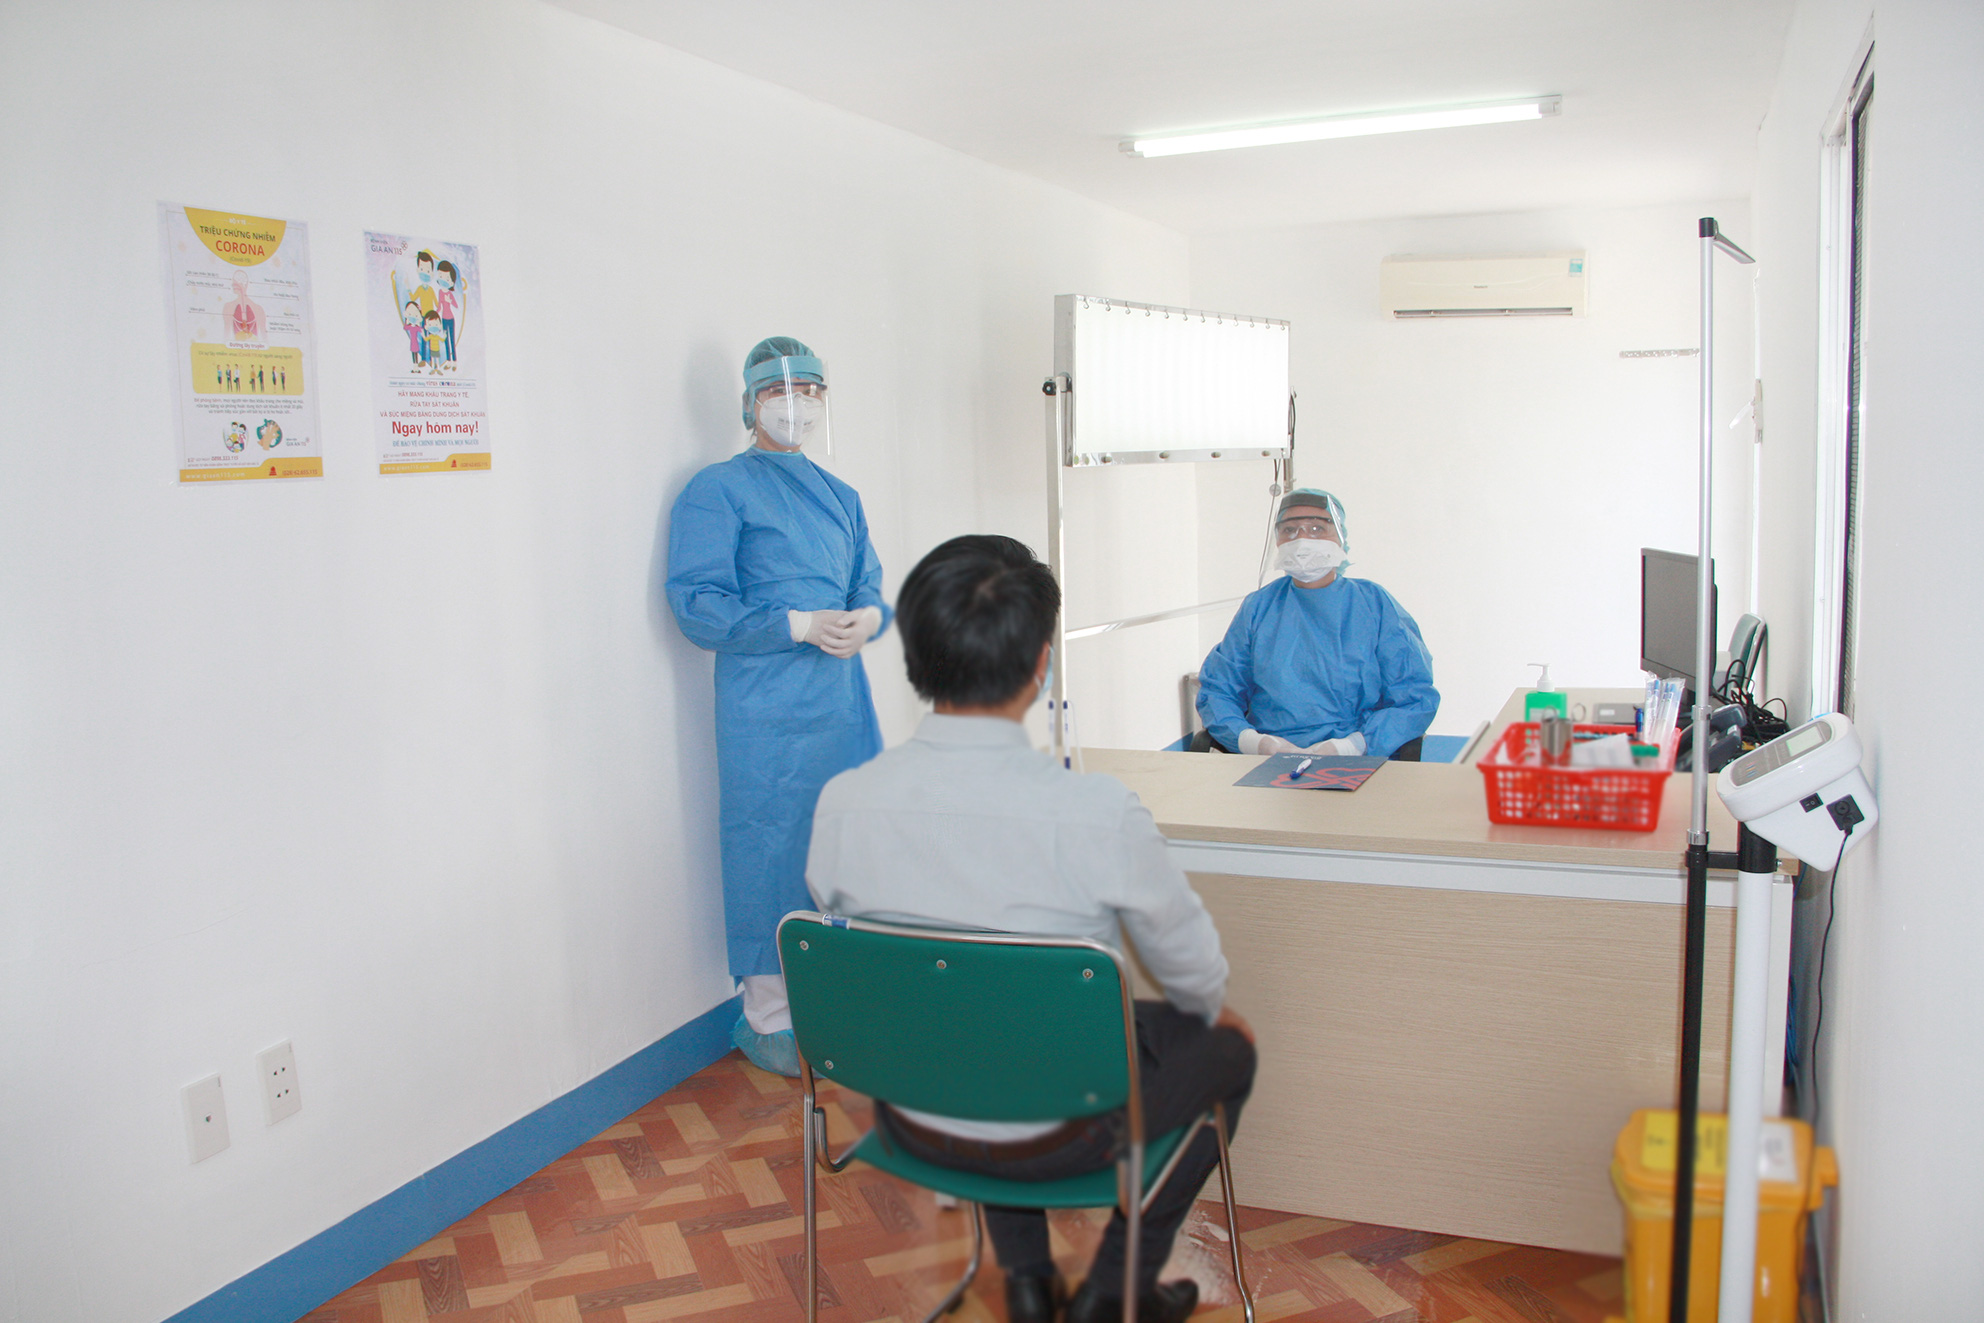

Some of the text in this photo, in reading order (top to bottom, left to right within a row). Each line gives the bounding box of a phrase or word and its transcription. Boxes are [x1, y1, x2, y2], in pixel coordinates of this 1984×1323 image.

[200, 225, 221, 236] TRIỆU
[223, 228, 251, 239] CHỨNG
[216, 240, 265, 256] CORONA
[392, 421, 478, 437] Ngay hôm nay!
